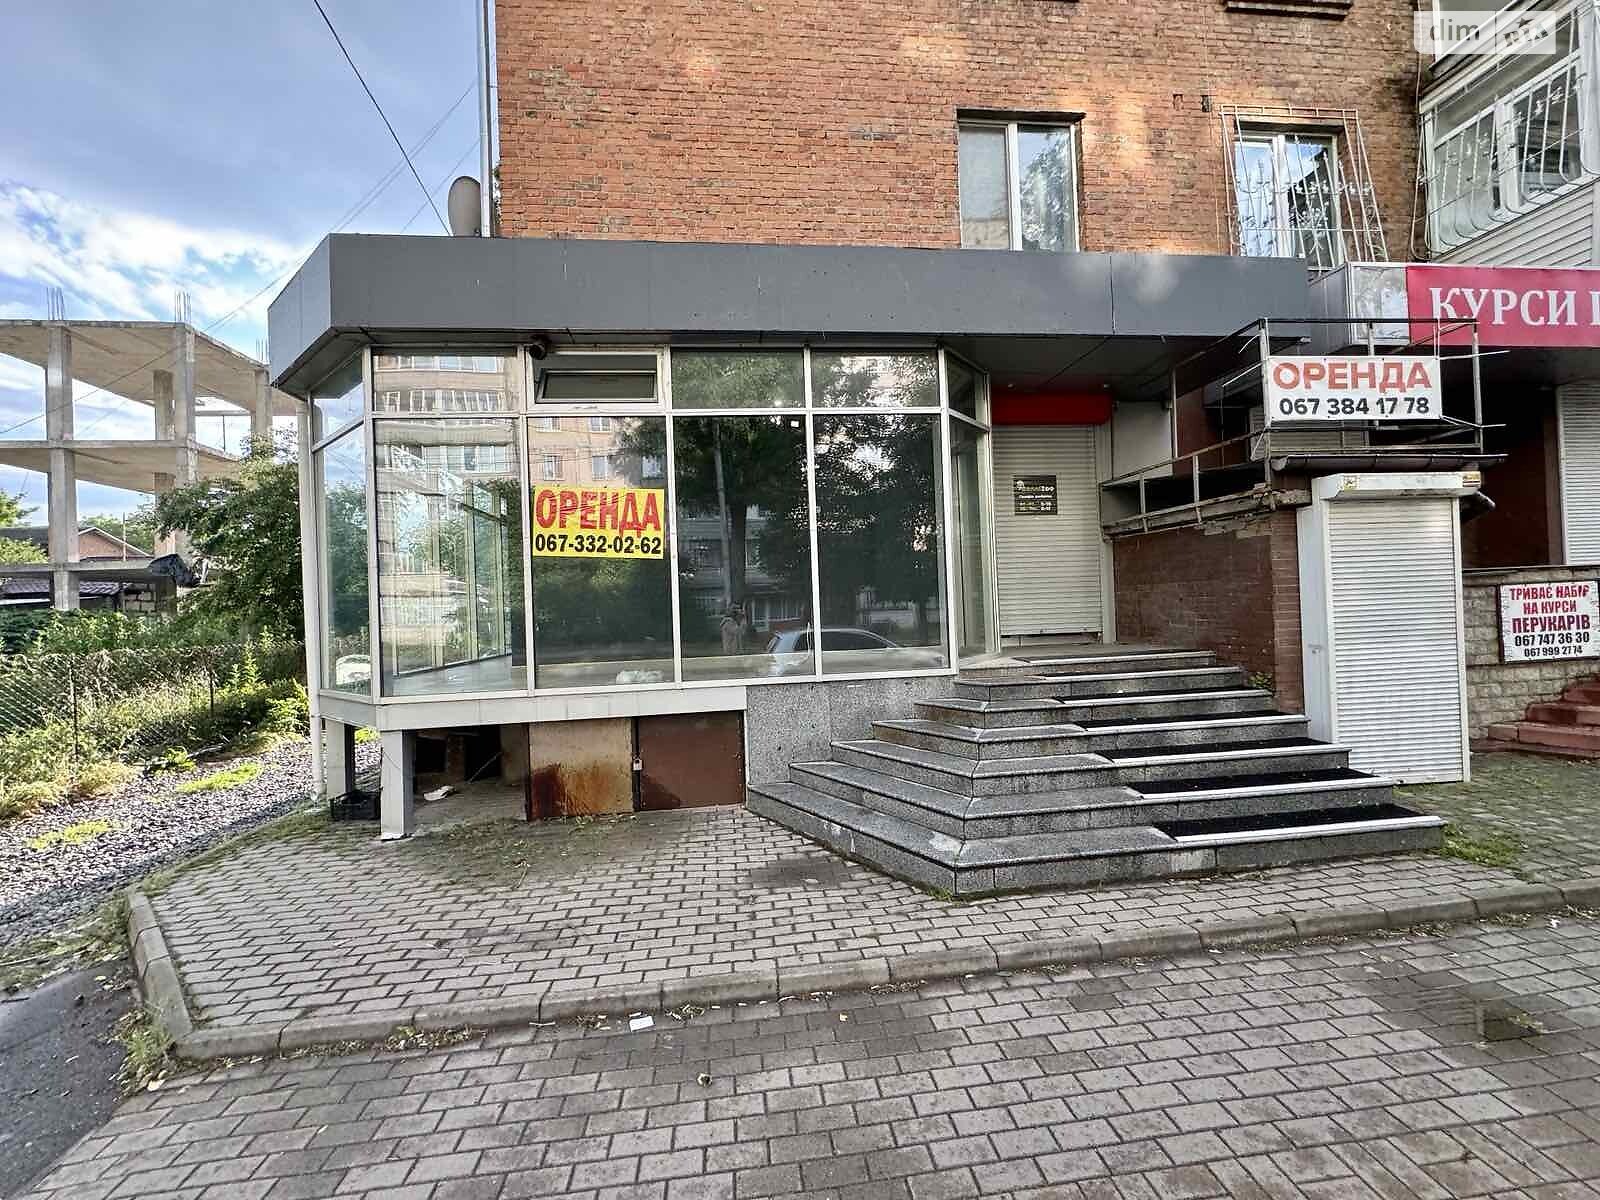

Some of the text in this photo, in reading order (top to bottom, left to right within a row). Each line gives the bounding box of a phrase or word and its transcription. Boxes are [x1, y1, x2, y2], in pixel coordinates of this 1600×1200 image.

[1429, 287, 1578, 326] КУРСИ
[1273, 362, 1432, 393] ОРЕНДА
[1279, 397, 1429, 415] 067 384 17 78
[536, 489, 661, 538] ОРЕНДА
[535, 533, 662, 554] 067-332-02-62
[1510, 586, 1553, 600] ТРИВАЄ
[1523, 600, 1577, 615] НА КУРСИ
[1512, 614, 1591, 633] ПЕРУКАРІВ
[1514, 631, 1590, 647] 067 747 36 30
[1524, 648, 1540, 657] 067
[1542, 646, 1560, 656] 999
